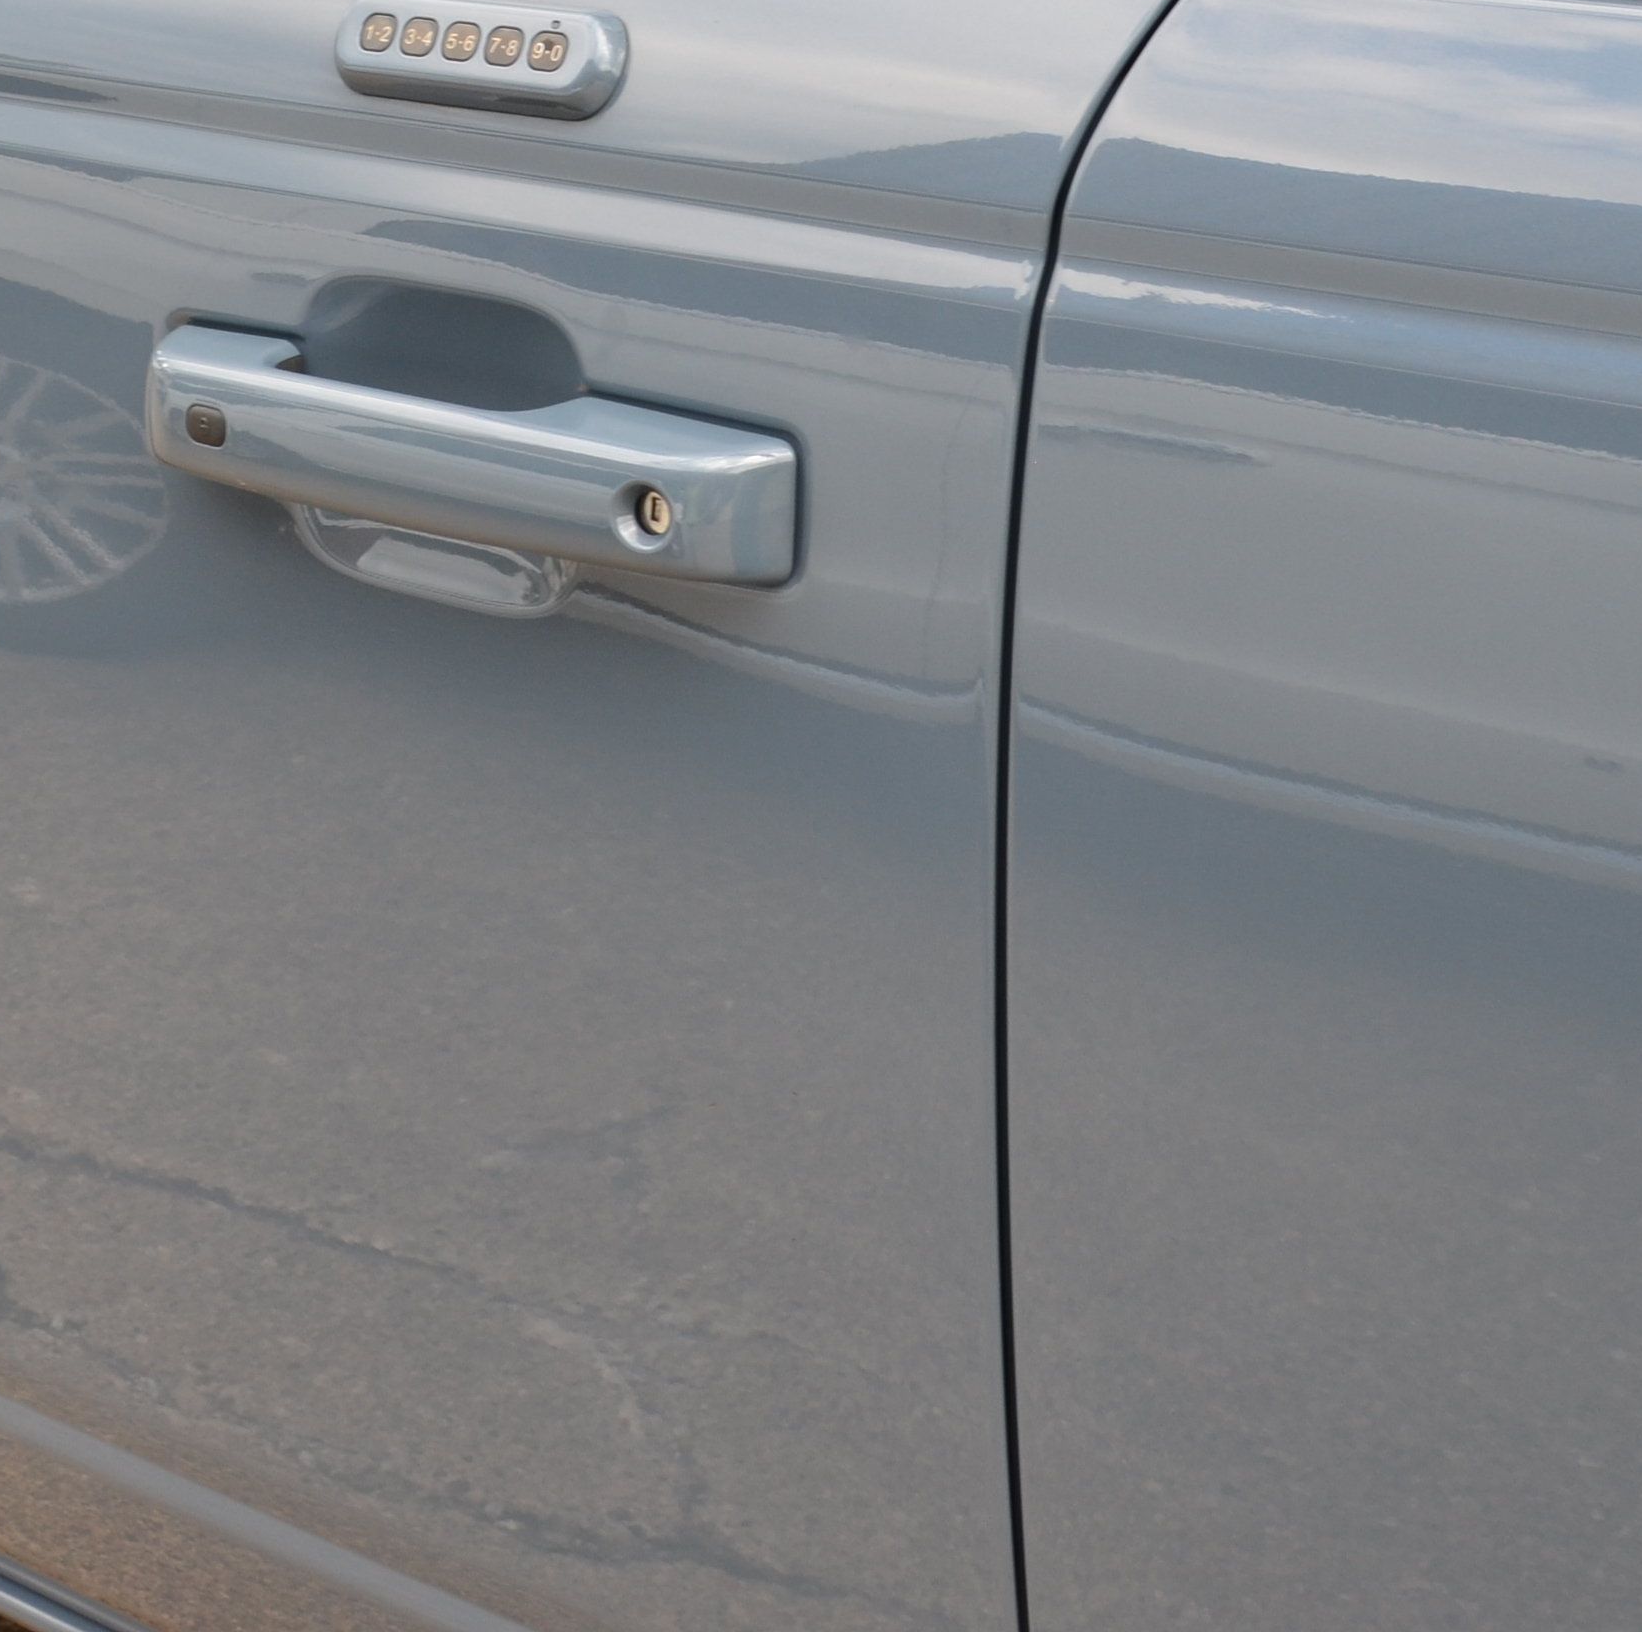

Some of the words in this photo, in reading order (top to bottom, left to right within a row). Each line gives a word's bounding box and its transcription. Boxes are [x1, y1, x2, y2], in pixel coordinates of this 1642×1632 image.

[365, 24, 392, 44] 1-2
[404, 27, 433, 47] 3-4
[445, 32, 476, 53] 5-6
[489, 37, 518, 57] 7-8
[531, 41, 565, 62] 9-0
